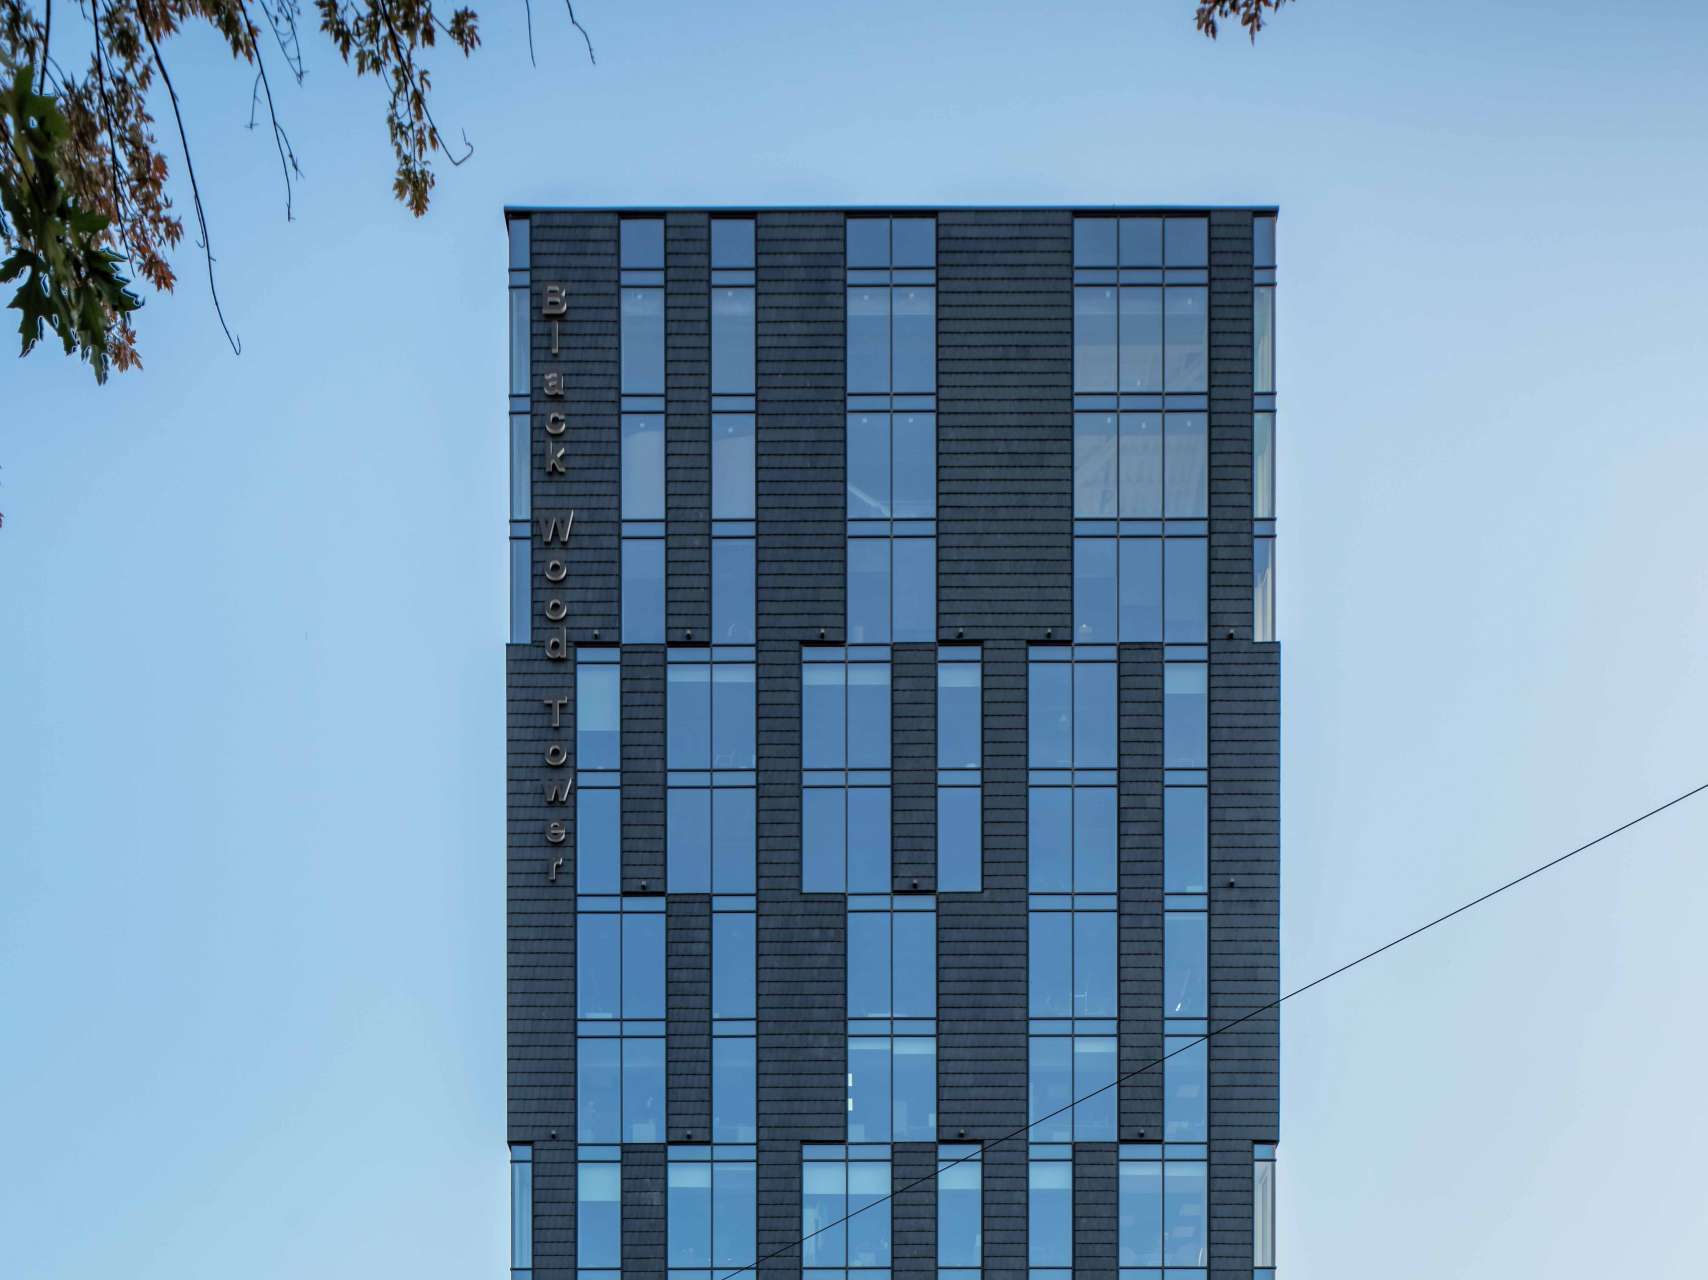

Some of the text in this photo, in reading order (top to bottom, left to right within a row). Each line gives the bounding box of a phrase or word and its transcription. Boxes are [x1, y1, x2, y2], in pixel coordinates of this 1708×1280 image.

[538, 285, 574, 881] Black Wood Tower
